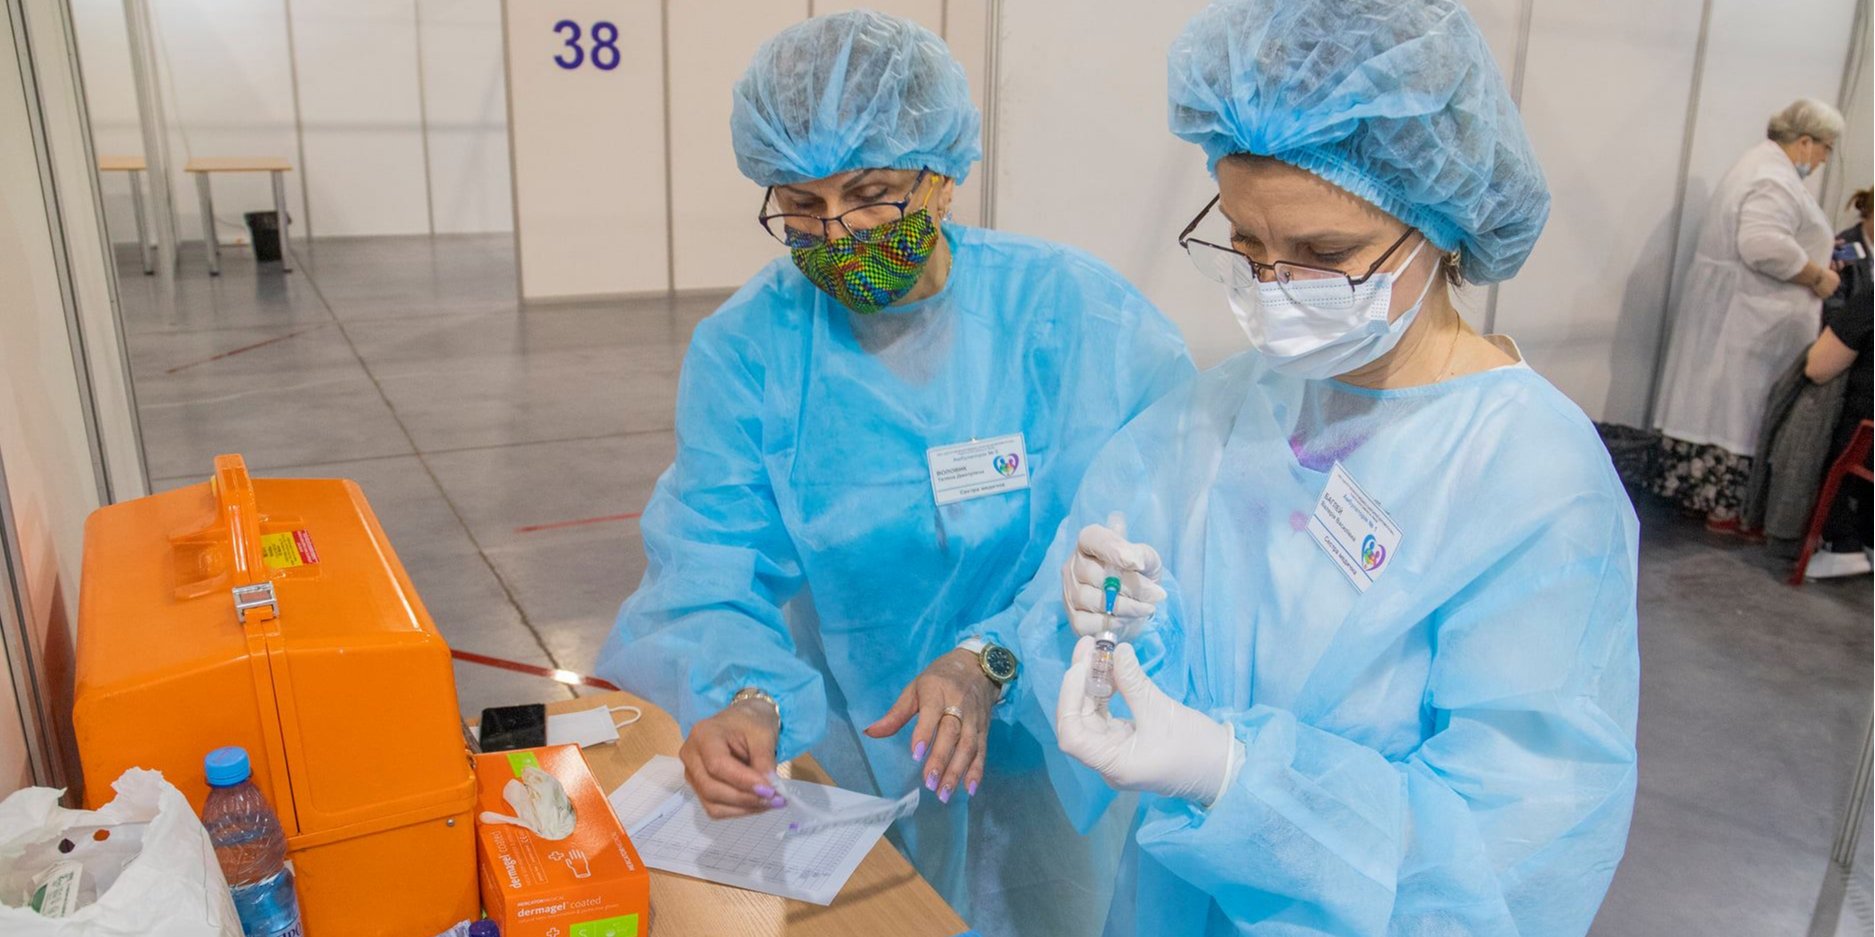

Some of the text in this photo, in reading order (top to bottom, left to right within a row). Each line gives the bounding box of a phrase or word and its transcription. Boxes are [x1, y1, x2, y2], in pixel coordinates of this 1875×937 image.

[553, 20, 621, 71] 38
[501, 854, 522, 889] dermagel
[517, 901, 566, 918] dermagel
[570, 896, 602, 909] coated
